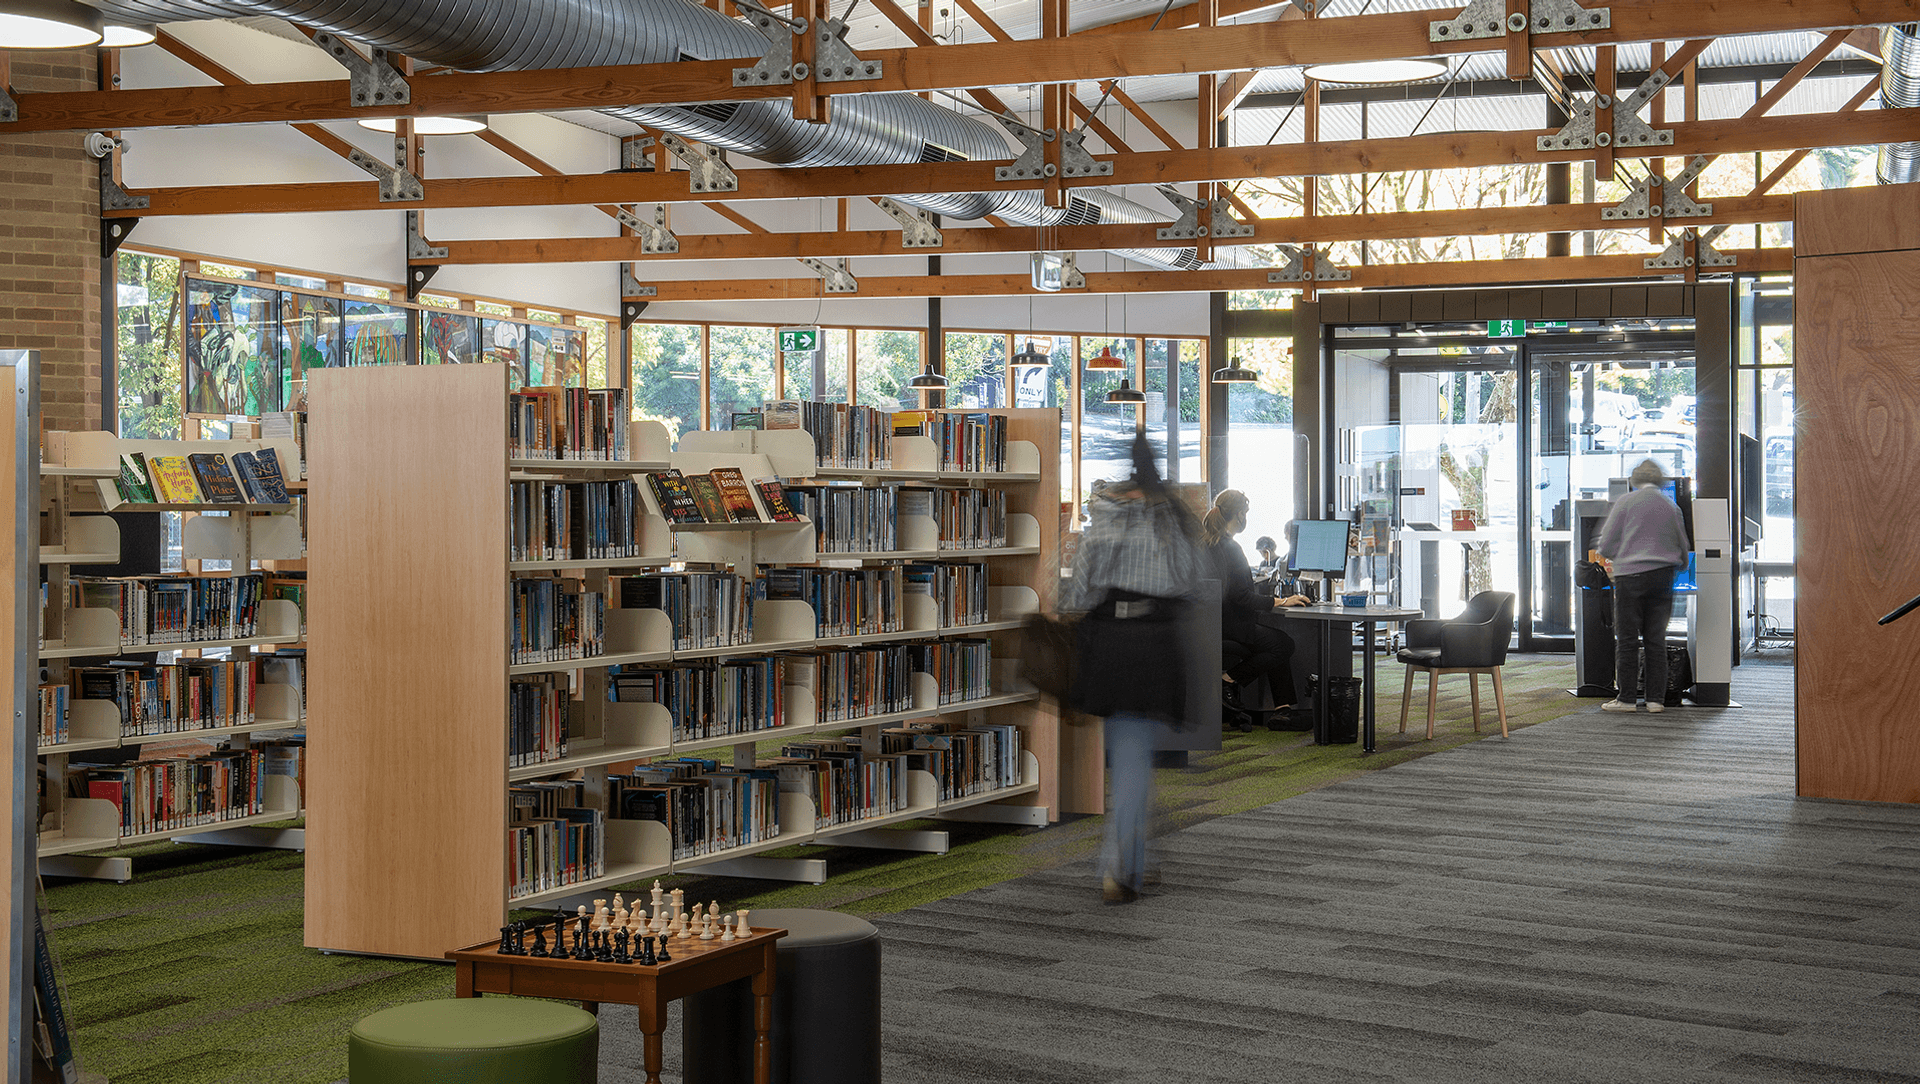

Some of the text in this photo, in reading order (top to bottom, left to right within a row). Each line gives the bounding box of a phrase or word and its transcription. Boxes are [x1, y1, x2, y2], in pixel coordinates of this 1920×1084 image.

[1019, 387, 1043, 396] ONLY
[204, 474, 234, 483] Hiding
[721, 471, 737, 479] GREG
[662, 480, 679, 488] WITH
[210, 485, 236, 494] Place
[36, 931, 54, 995] ENCYCLOPEDIA
[55, 1009, 65, 1038] GAMES
